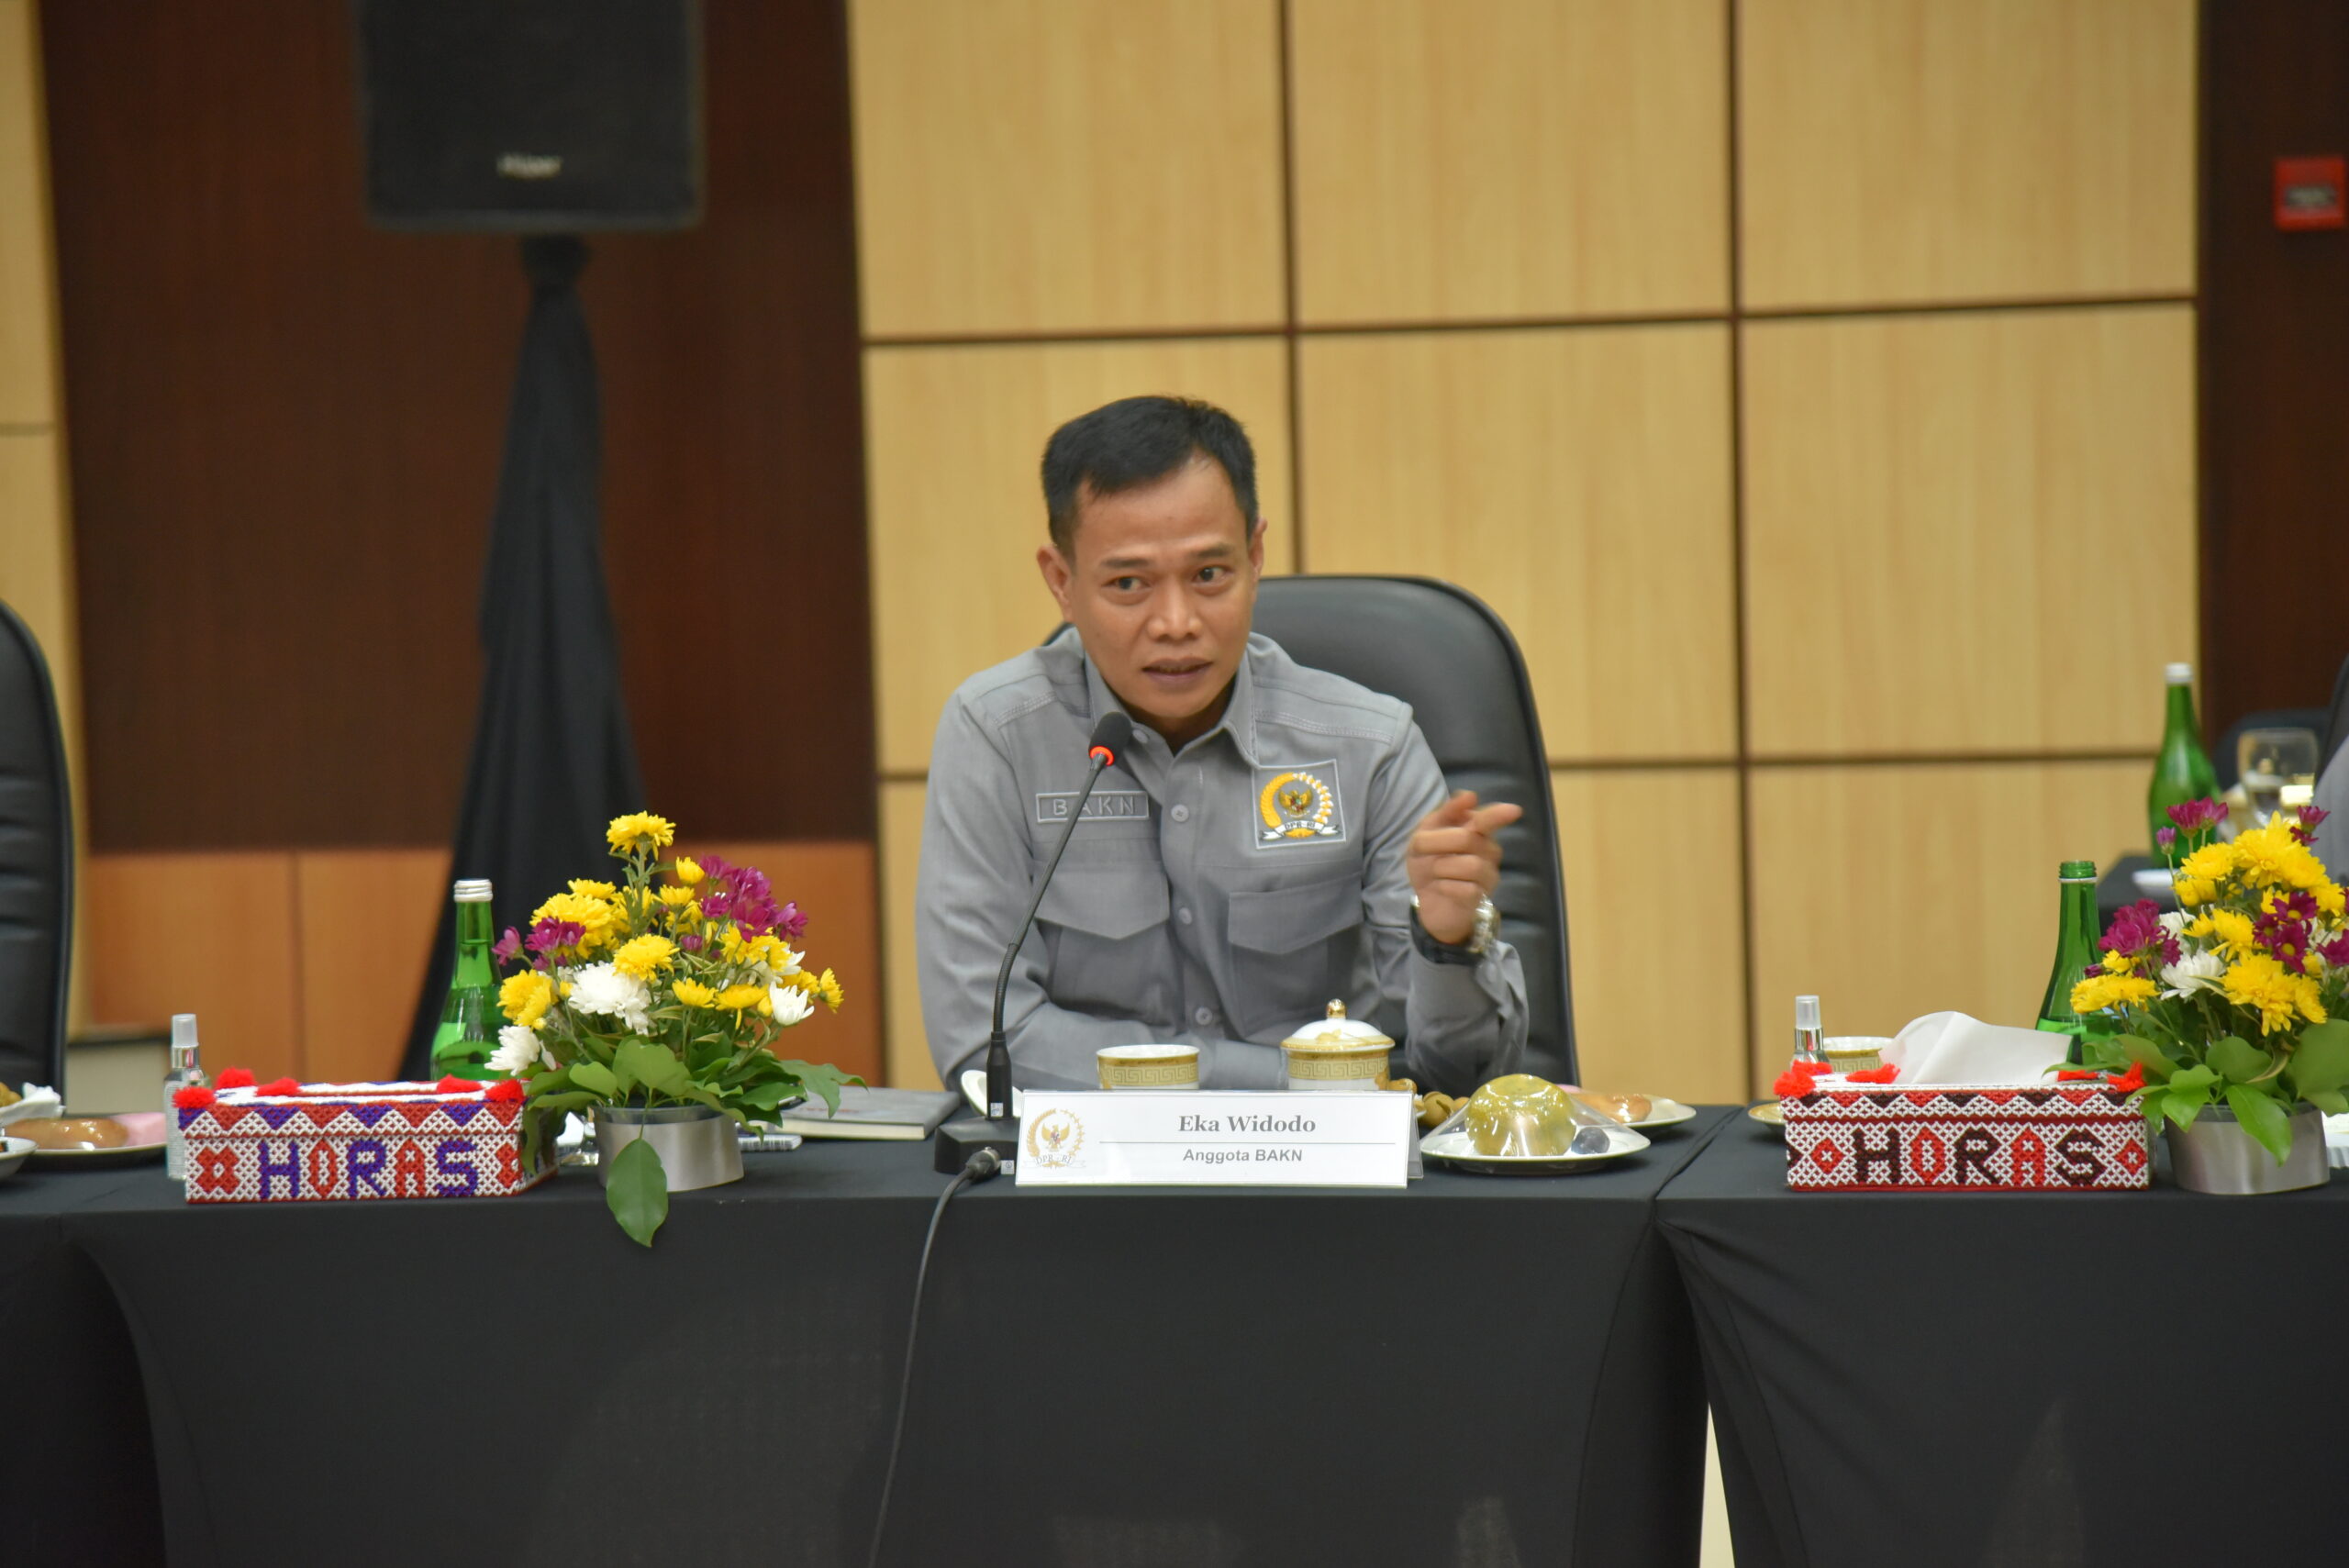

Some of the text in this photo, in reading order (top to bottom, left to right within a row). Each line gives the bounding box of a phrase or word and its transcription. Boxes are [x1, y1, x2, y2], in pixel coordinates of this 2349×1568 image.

[1178, 1114, 1317, 1133] Eka Widodo
[258, 1139, 479, 1199] HORAS
[1183, 1149, 1303, 1164] Anggota BAKN
[1852, 1127, 2107, 1186] HORAS
